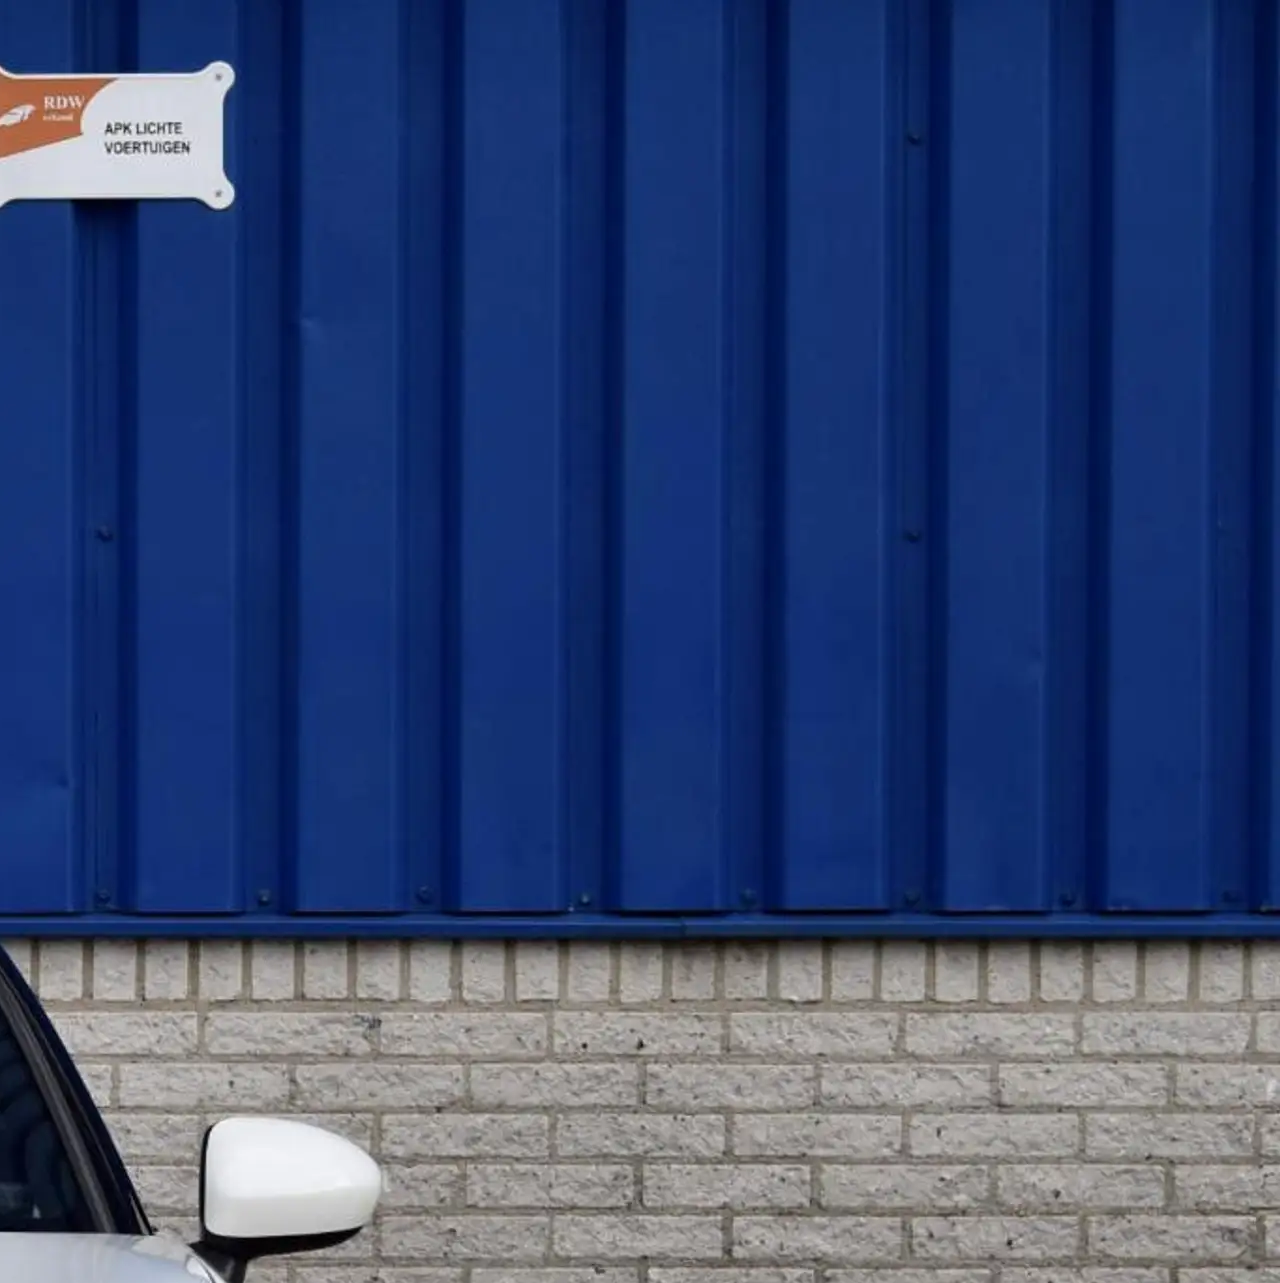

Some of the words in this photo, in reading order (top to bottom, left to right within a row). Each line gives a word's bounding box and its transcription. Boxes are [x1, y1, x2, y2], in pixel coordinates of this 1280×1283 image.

[43, 95, 86, 110] RDW
[104, 121, 133, 136] APK
[135, 121, 183, 136] LICHTE
[104, 140, 191, 155] VOERTUIGEN
